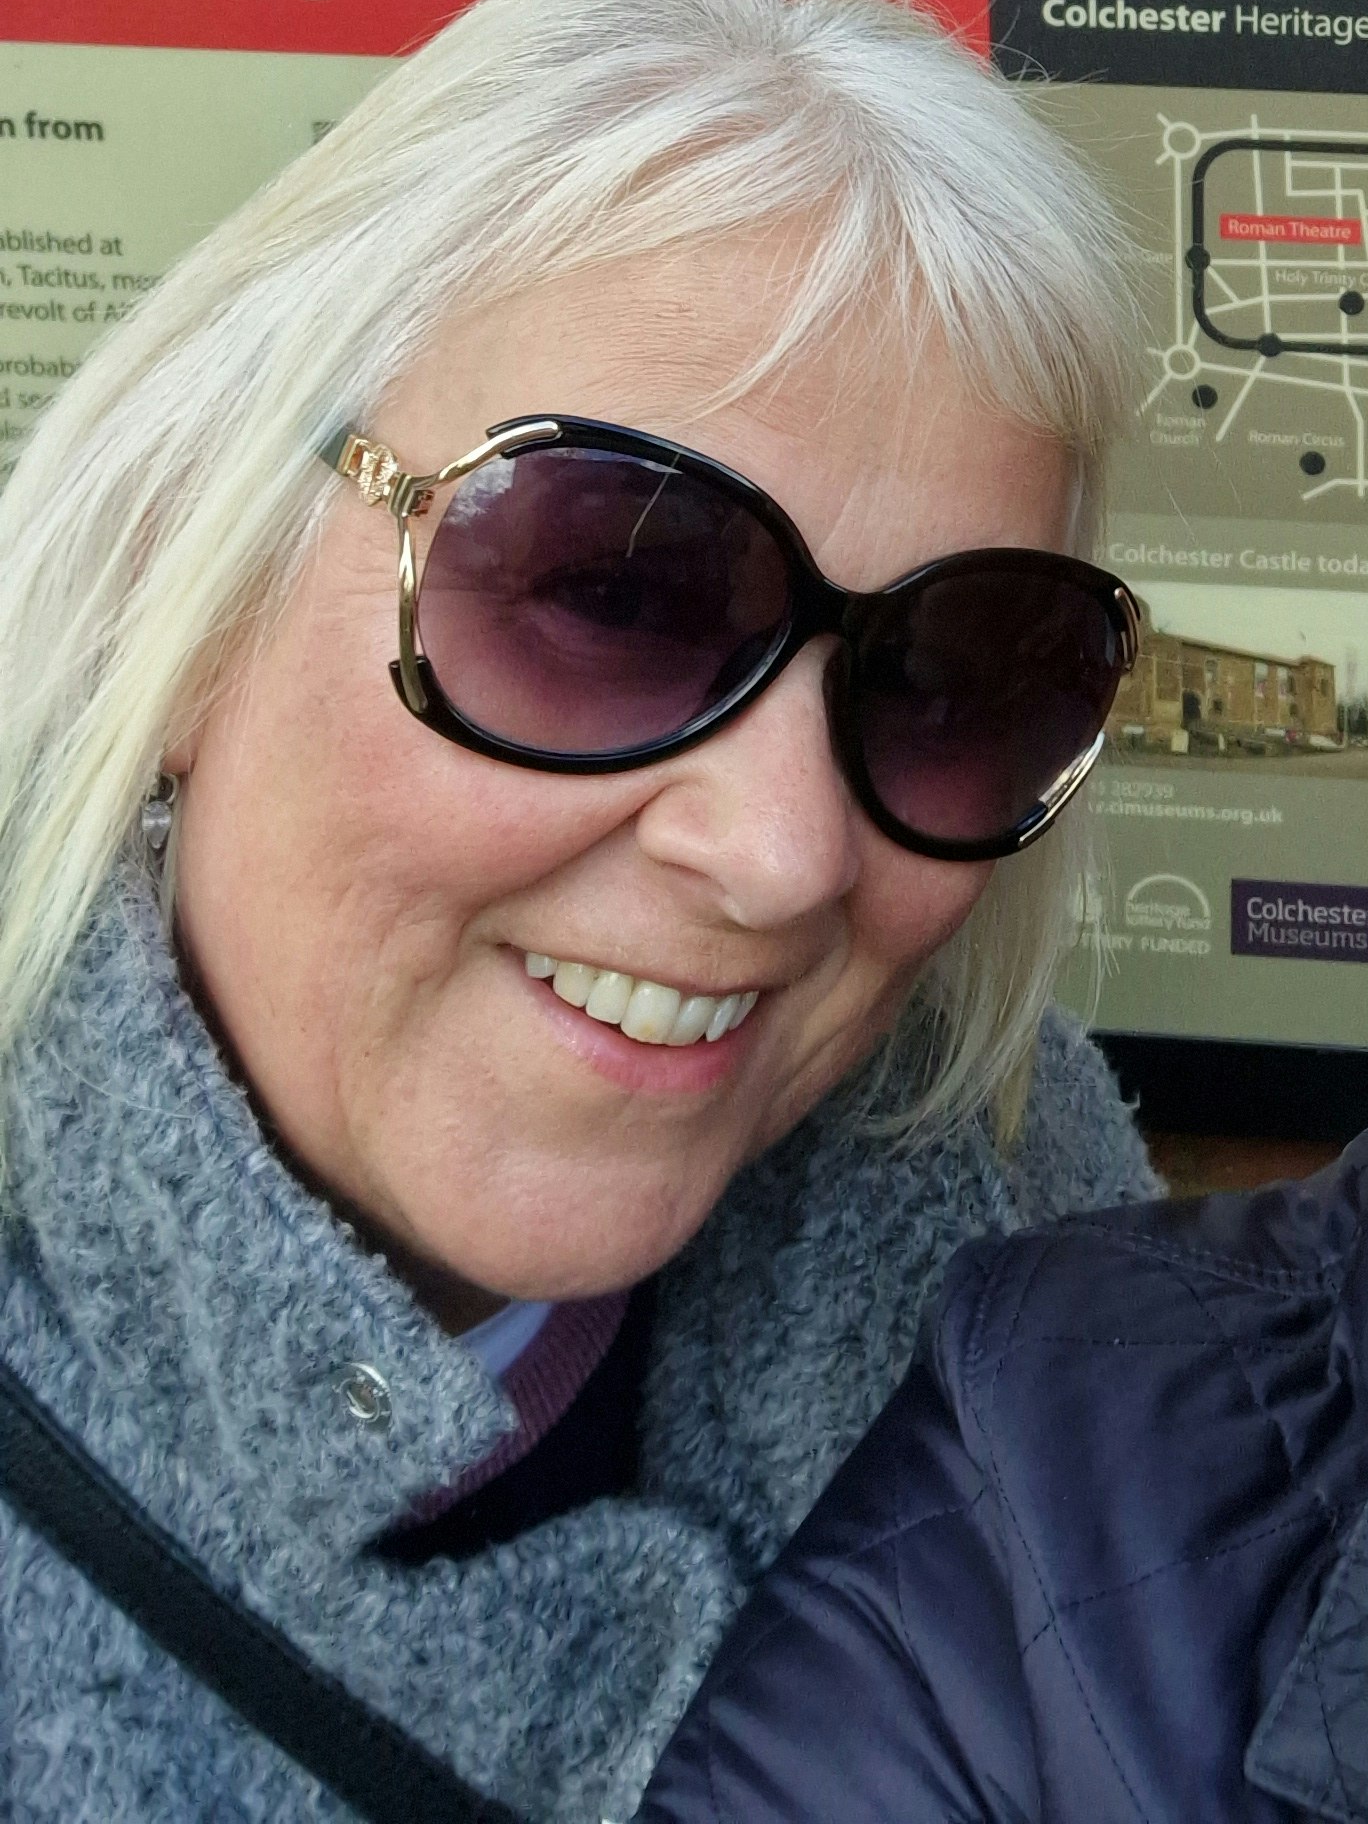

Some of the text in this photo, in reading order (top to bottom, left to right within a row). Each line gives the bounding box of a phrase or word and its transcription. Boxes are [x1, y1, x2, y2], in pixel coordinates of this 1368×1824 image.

[25, 110, 104, 141] from
[1229, 219, 1352, 240] Roman Theatre
[101, 237, 123, 256] at
[17, 264, 106, 291] Tacitus,
[1275, 270, 1308, 287] Holy
[1312, 271, 1355, 289] Trinity
[72, 302, 97, 323] of
[1248, 429, 1346, 447] Roman Circus
[1108, 542, 1233, 570] Colchester
[1239, 549, 1311, 573] Castle
[1247, 922, 1368, 951] Museums
